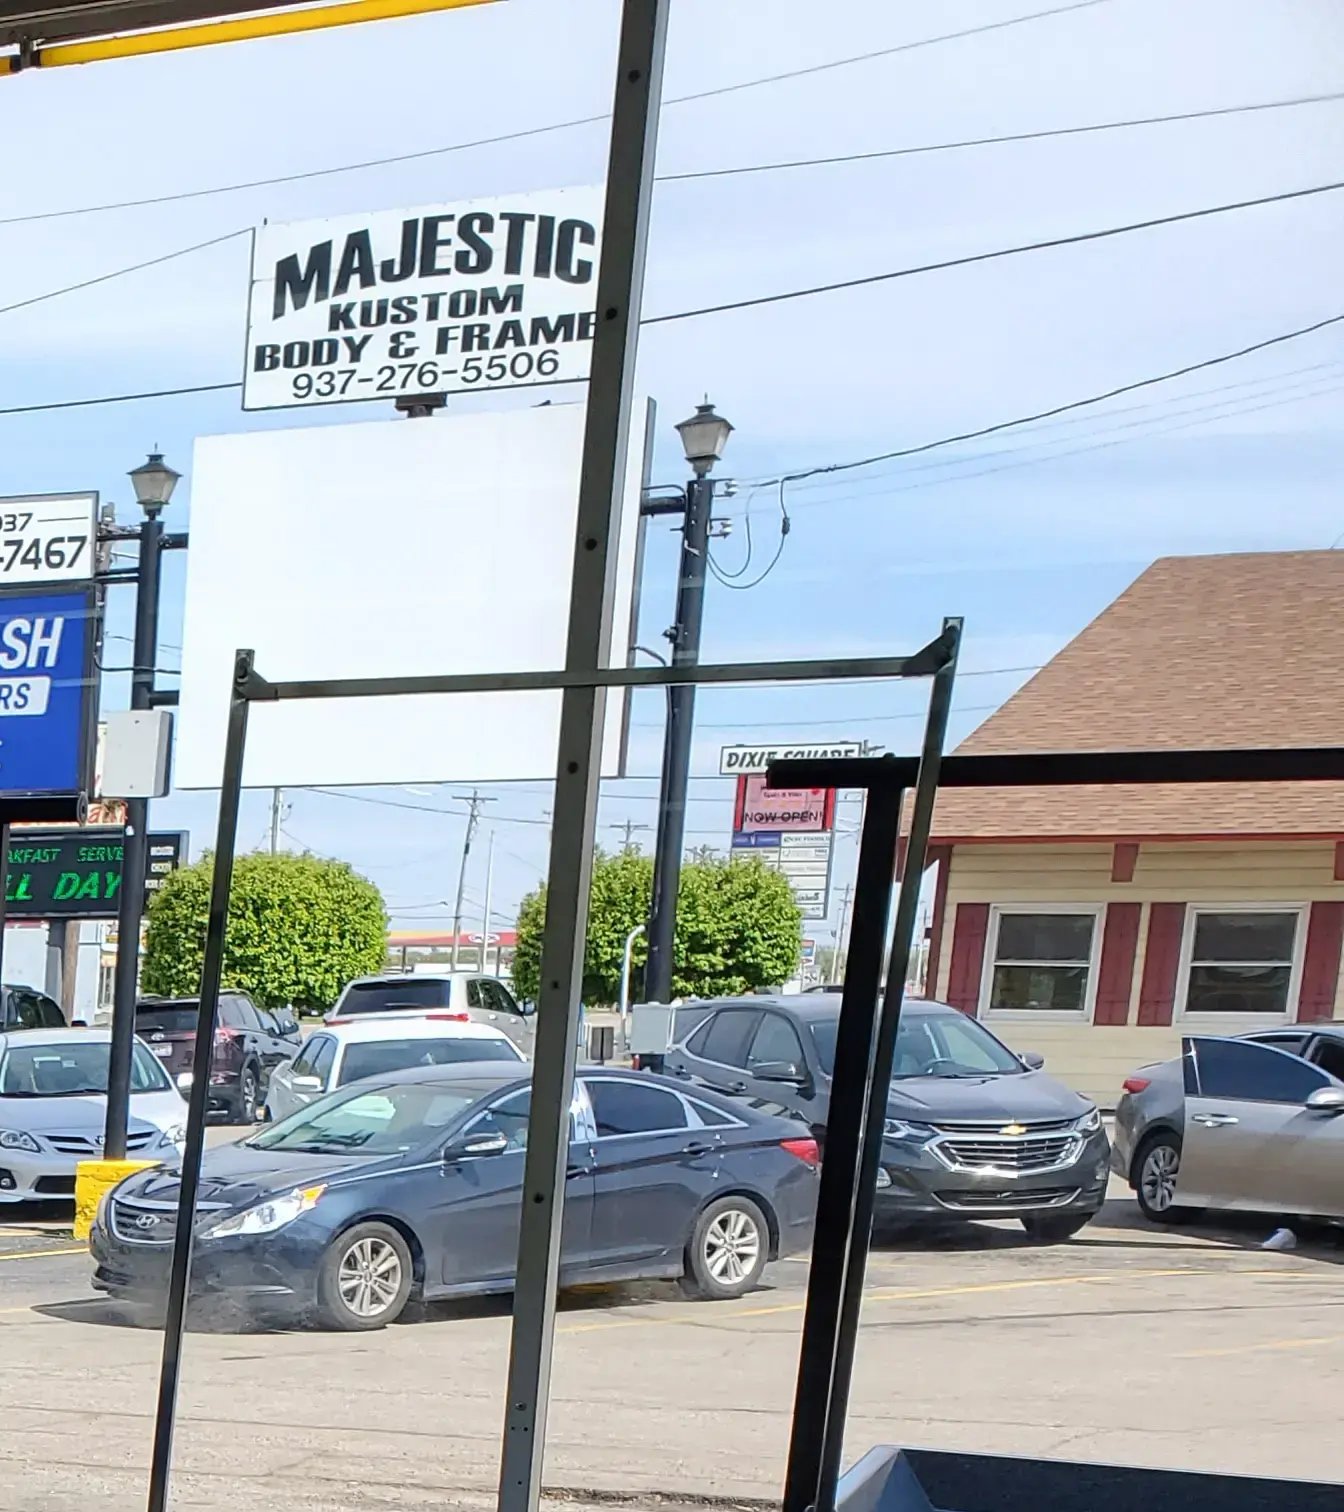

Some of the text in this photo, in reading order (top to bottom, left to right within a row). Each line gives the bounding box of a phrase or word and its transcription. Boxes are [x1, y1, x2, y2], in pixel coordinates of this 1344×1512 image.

[272, 211, 596, 321] MAJESTIC
[327, 283, 525, 332] KUSTOM
[253, 333, 374, 373] BODY
[388, 330, 420, 360] &
[292, 348, 560, 400] 937-276-5506
[744, 811, 777, 823] NOW
[53, 871, 122, 900] DAY
